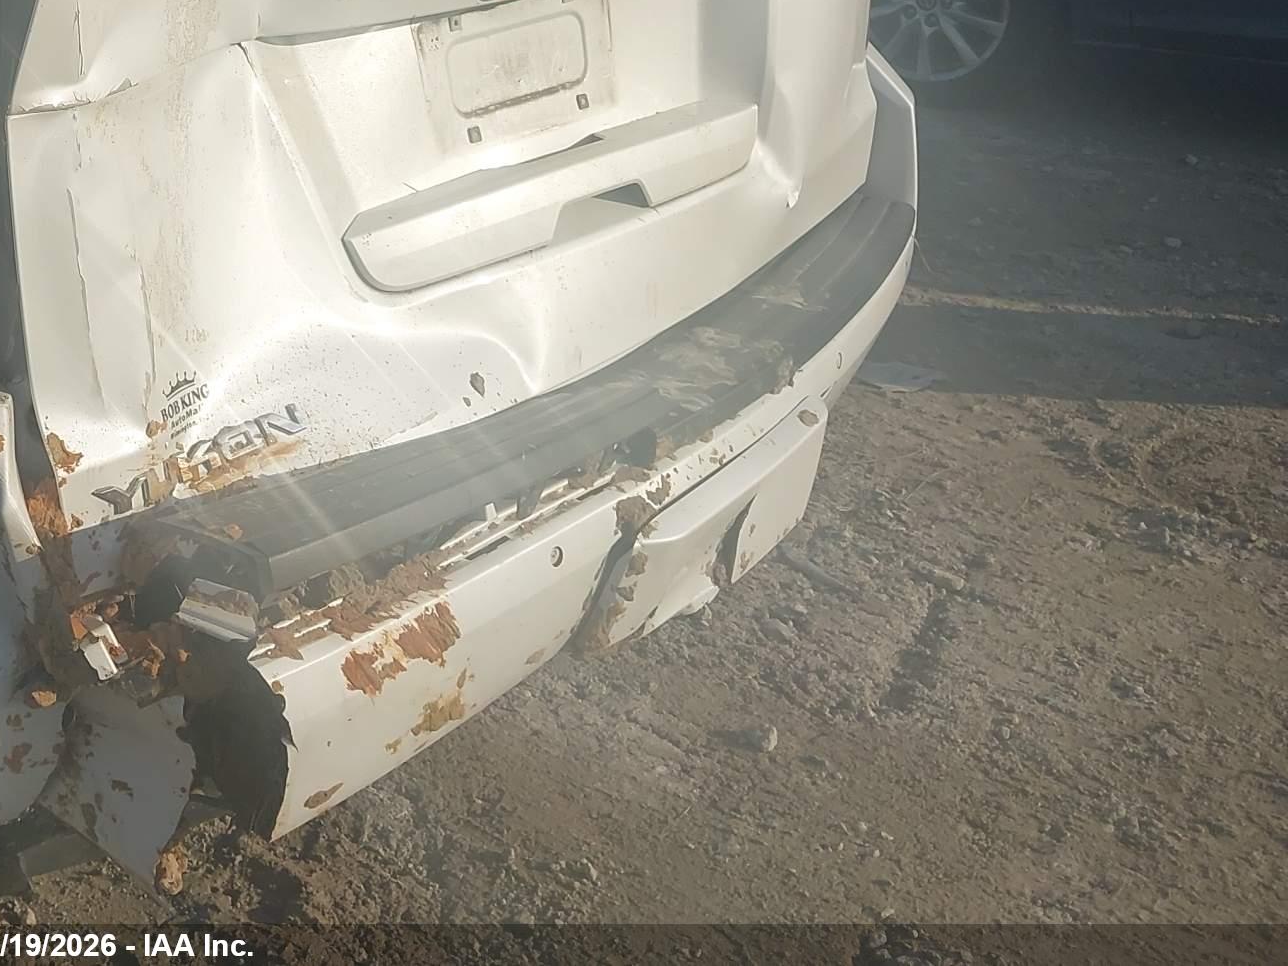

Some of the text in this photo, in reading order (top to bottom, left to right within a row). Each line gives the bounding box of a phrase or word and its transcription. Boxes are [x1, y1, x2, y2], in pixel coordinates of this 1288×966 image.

[160, 383, 209, 422] BOB KING
[91, 403, 307, 515] YUKON
